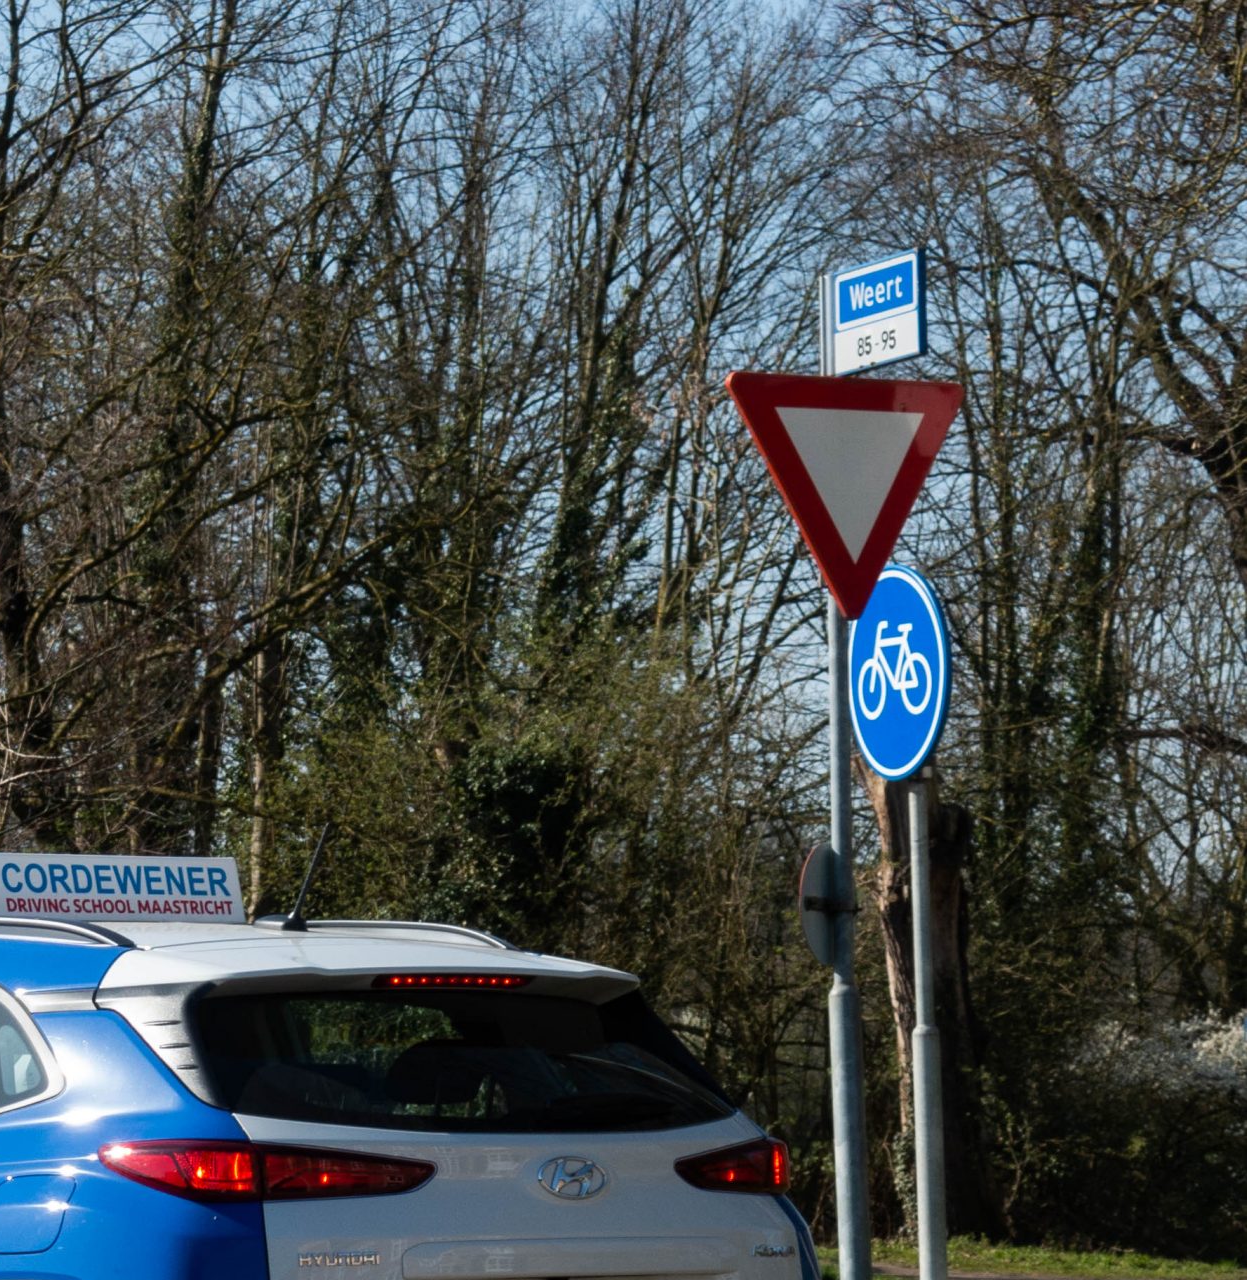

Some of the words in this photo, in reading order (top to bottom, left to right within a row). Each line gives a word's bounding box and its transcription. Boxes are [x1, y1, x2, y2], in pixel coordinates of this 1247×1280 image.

[849, 275, 903, 311] Weert
[1, 862, 231, 897] CORDEWENER
[6, 898, 70, 914] DRIVING
[74, 898, 135, 915] SCHOOL
[137, 899, 234, 916] MAASTRICHT
